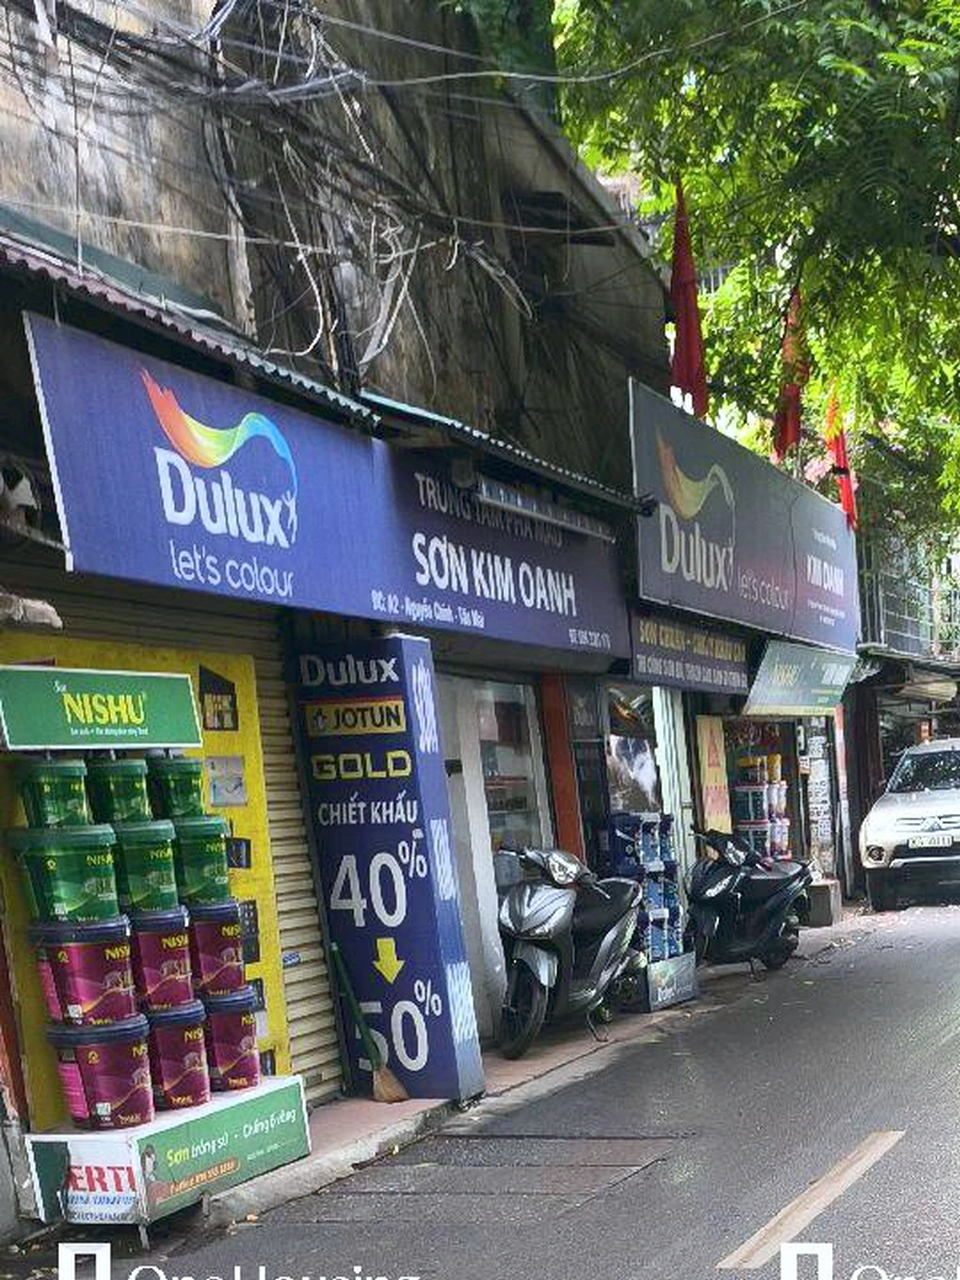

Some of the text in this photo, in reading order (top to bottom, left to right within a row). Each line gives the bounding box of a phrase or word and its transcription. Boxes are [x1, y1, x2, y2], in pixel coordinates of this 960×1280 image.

[154, 447, 290, 548] Dulux
[659, 503, 728, 592] Dulux
[170, 540, 293, 598] let's colour
[412, 533, 577, 617] SƠN KIM OANH
[301, 655, 399, 687] Dulux
[63, 692, 146, 725] NISHU
[333, 706, 401, 730] JOTUN
[311, 750, 411, 780] GOLD
[318, 789, 417, 826] CHIẾT KHẤU
